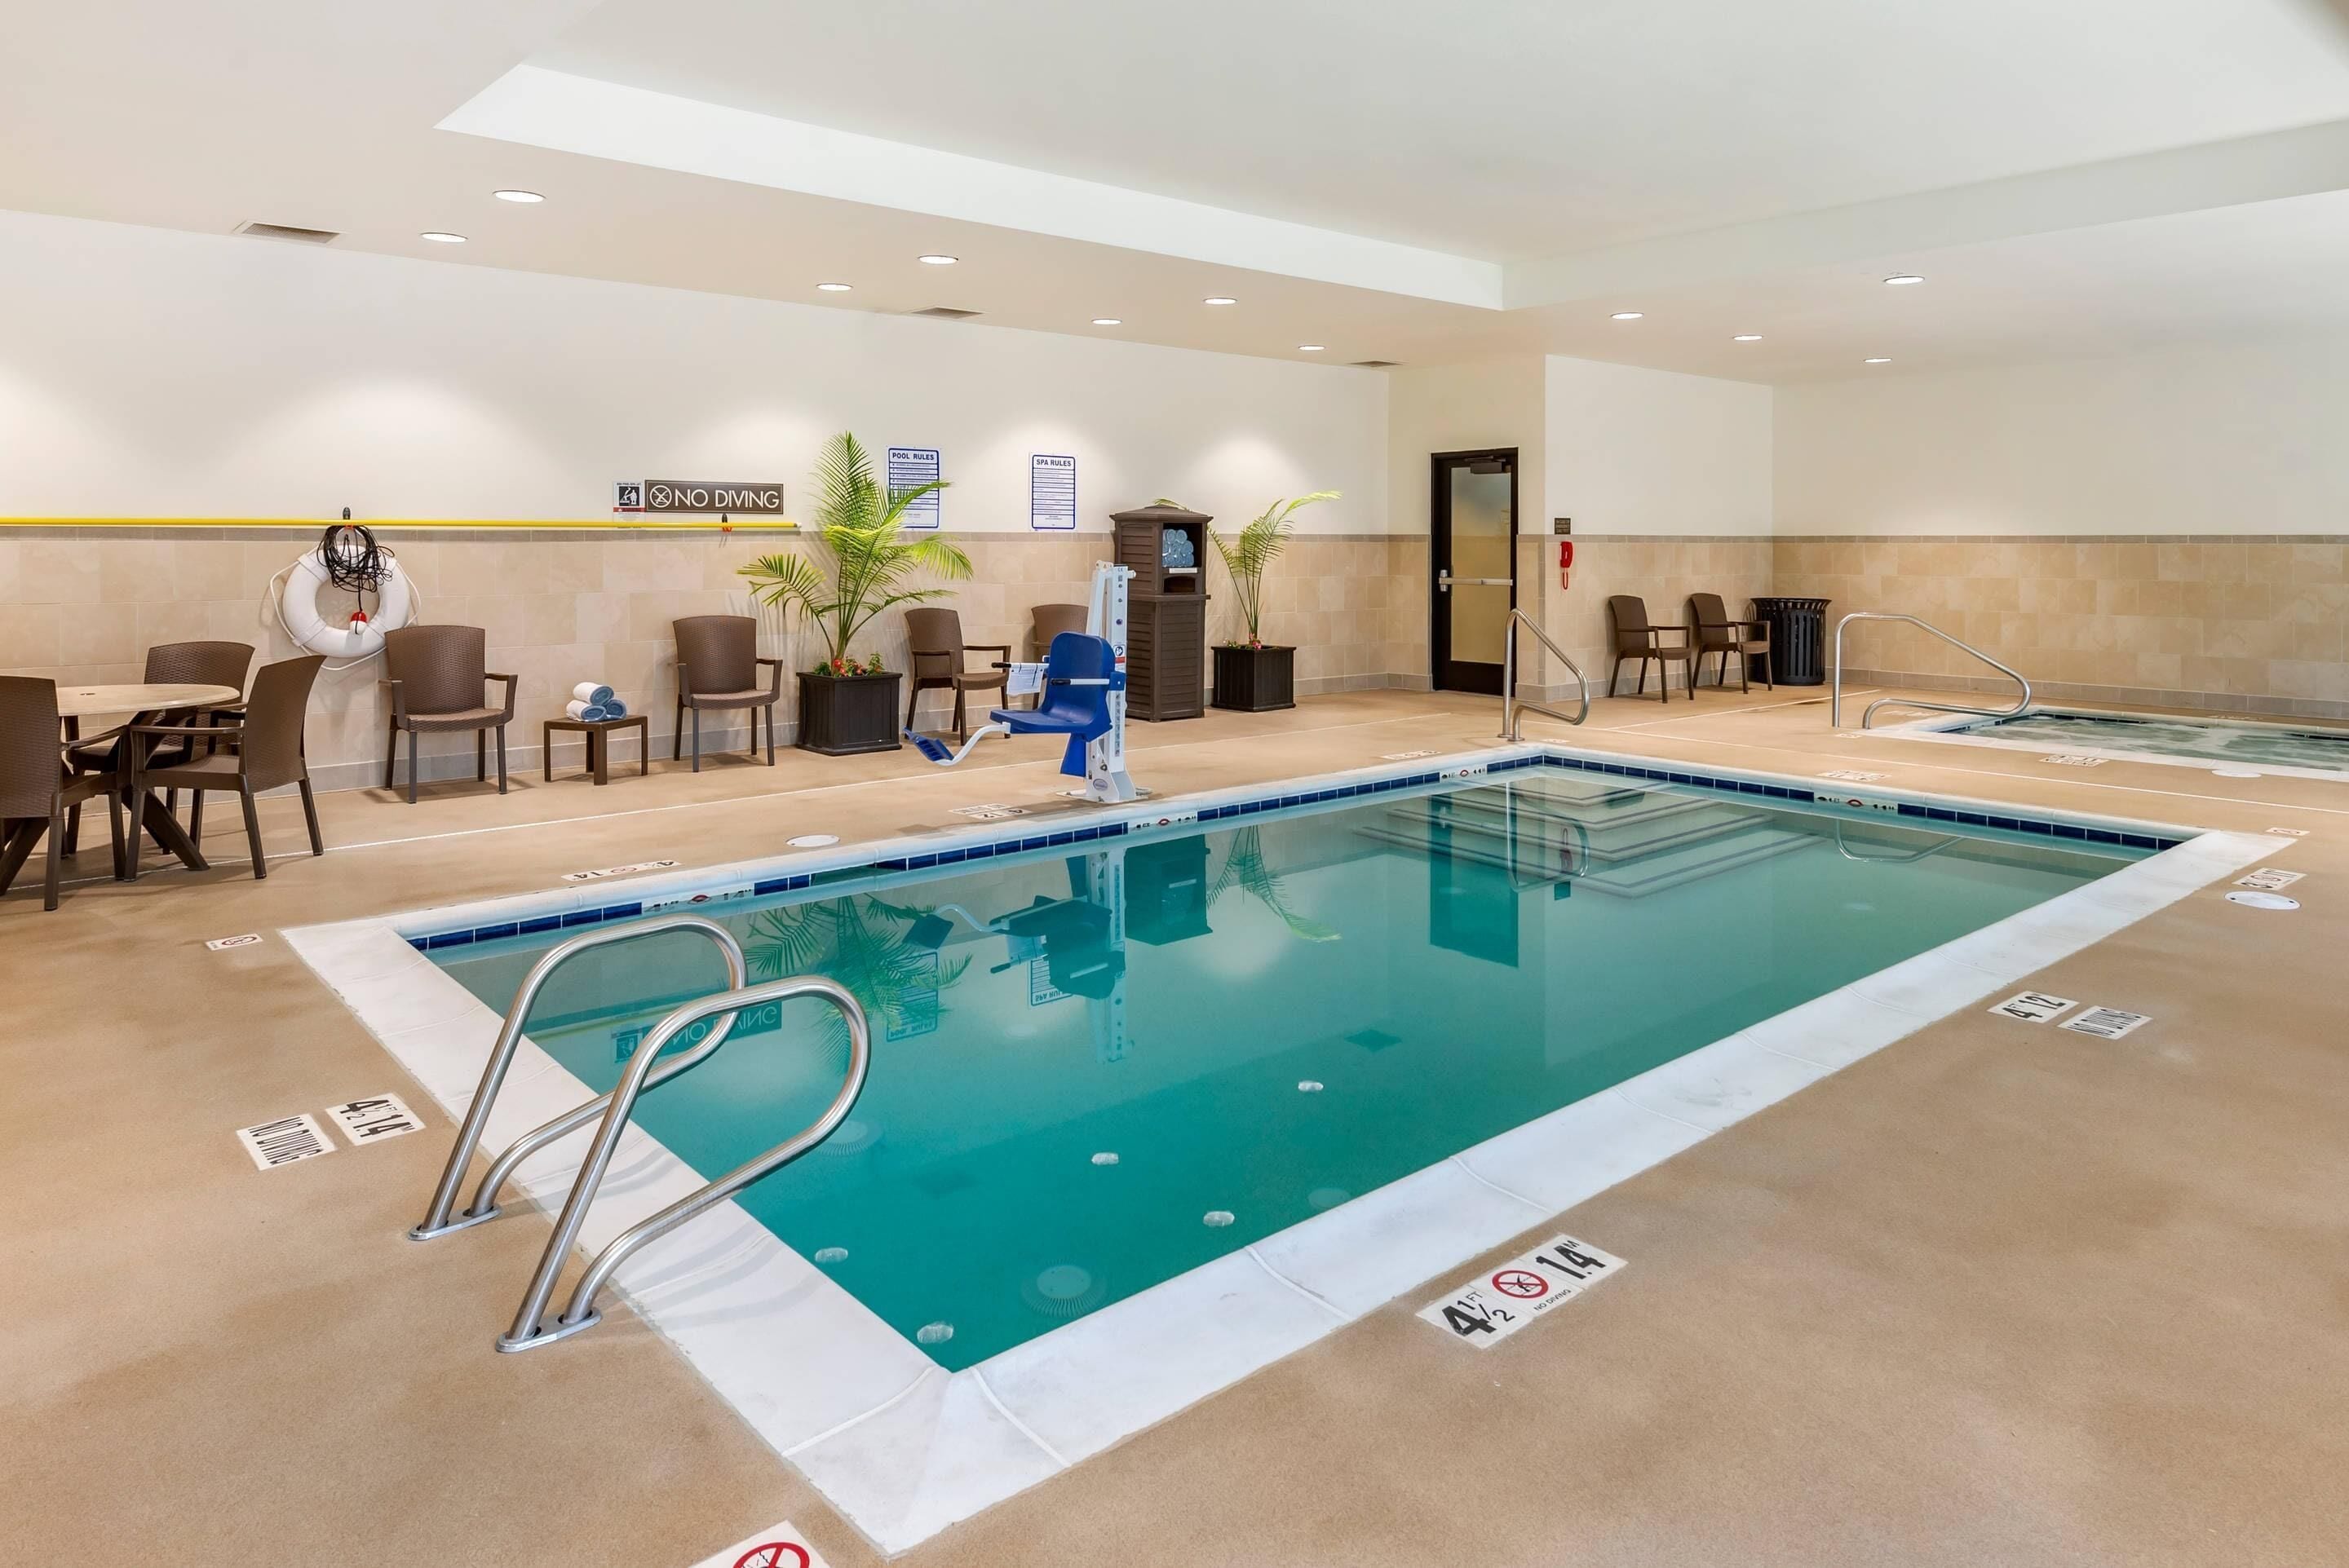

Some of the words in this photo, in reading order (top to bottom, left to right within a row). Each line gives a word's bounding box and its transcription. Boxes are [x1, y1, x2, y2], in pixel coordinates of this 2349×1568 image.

[675, 488, 709, 508] NO
[714, 489, 780, 509] DIVING
[248, 1116, 305, 1137] NO
[255, 1128, 324, 1166] DIVING
[1535, 1245, 1606, 1280] 1.4
[1466, 1291, 1484, 1304] FT
[1533, 1301, 1547, 1311] NO
[1546, 1288, 1572, 1305] DIVING
